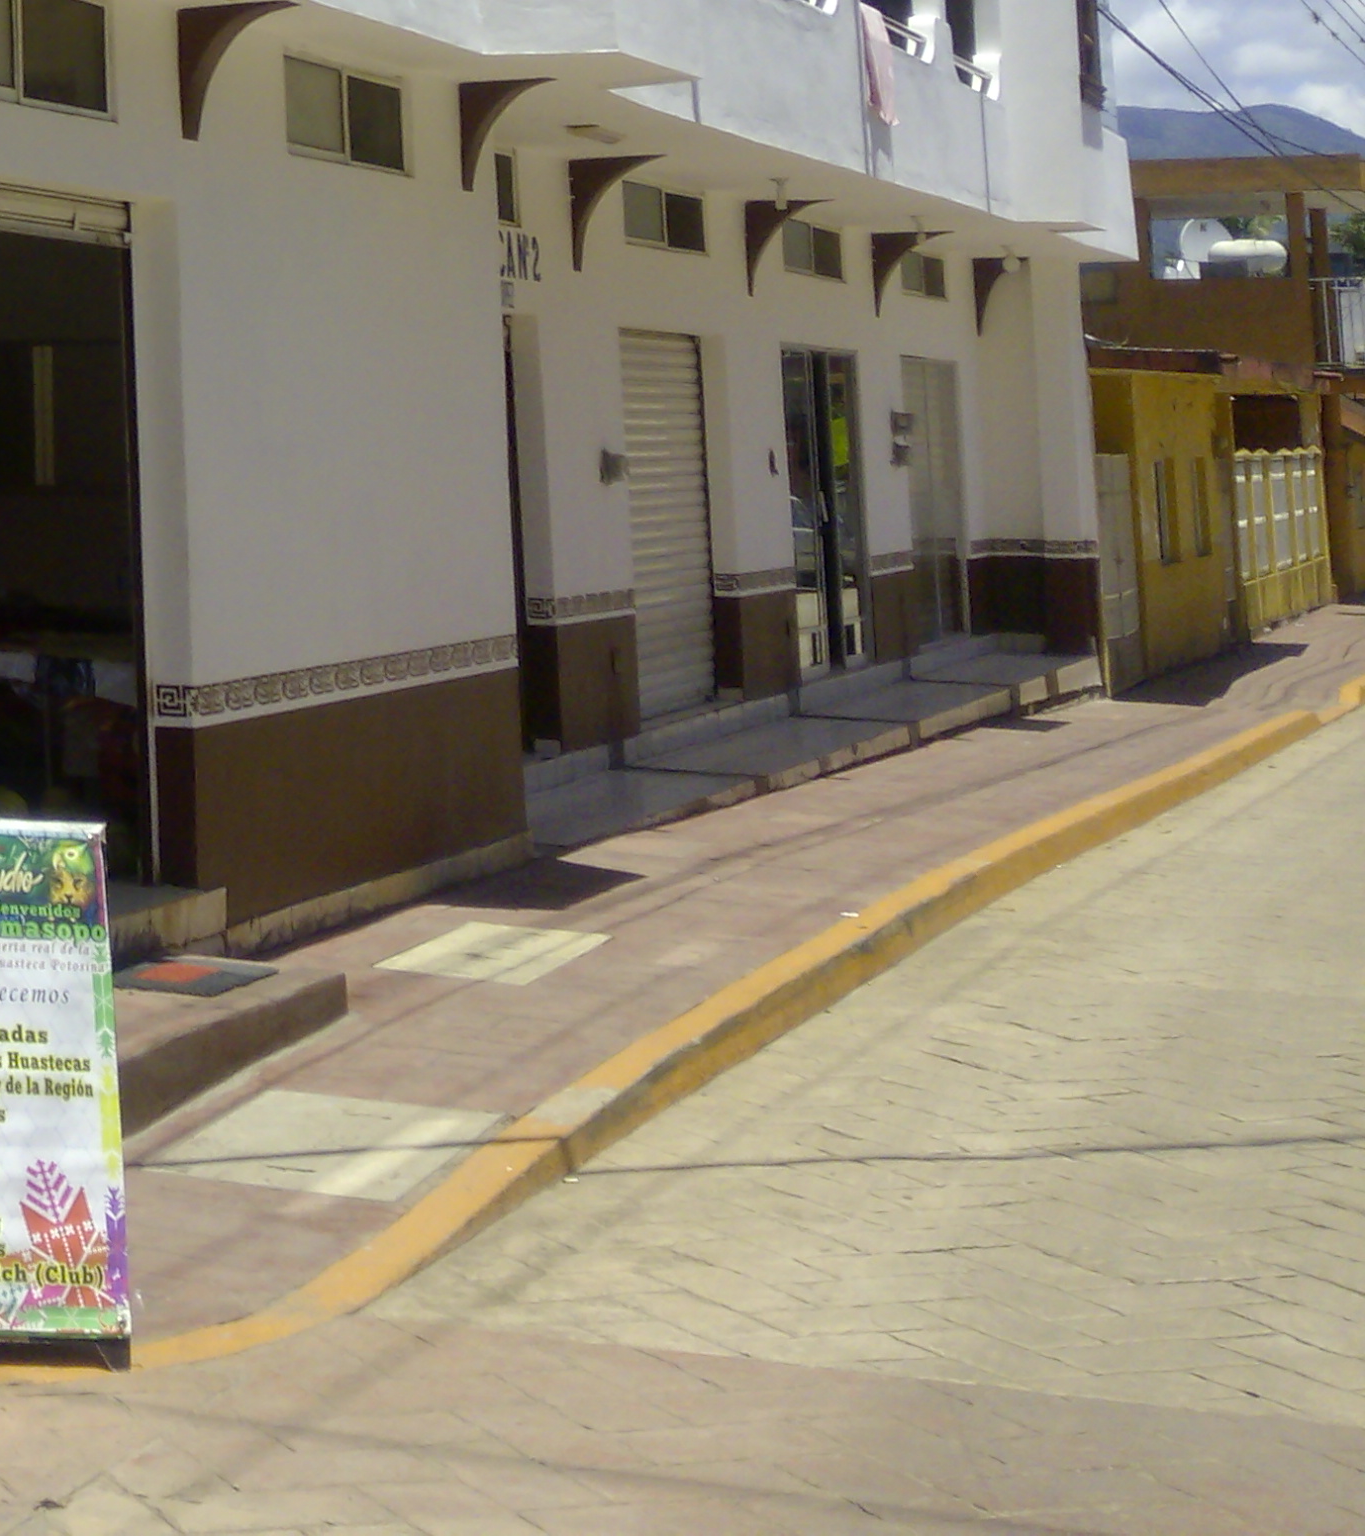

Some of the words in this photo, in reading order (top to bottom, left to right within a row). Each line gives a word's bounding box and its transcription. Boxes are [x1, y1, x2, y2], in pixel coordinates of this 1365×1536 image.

[31, 942, 55, 954] real
[60, 942, 73, 955] de
[78, 943, 90, 955] la
[50, 958, 106, 973] Potosina
[7, 1051, 91, 1073] Huastecas
[5, 1075, 23, 1095] de
[26, 1075, 40, 1095] la
[44, 1077, 94, 1101] Región
[35, 1264, 104, 1287] (Club)
